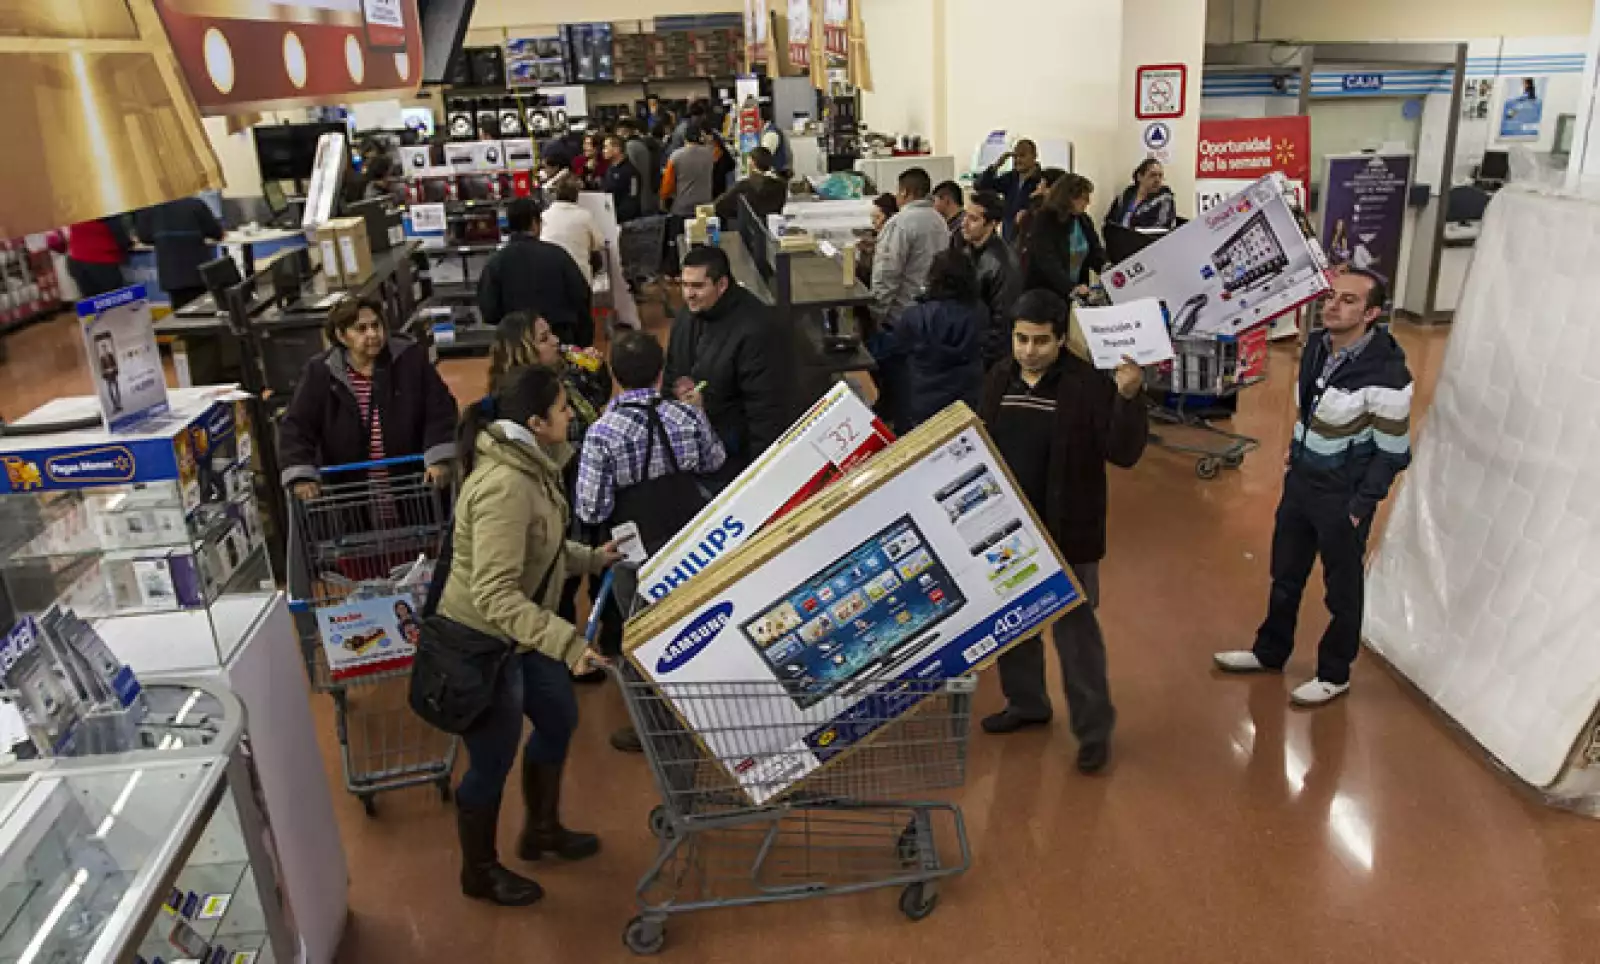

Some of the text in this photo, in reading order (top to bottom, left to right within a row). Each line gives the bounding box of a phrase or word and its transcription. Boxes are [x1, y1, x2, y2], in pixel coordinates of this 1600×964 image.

[1346, 76, 1380, 88] CAJA
[1199, 135, 1272, 156] Oportunidad
[1200, 156, 1272, 171] de la semana
[1126, 261, 1146, 279] LG
[648, 514, 746, 599] PHILIPS
[660, 611, 728, 663] SAMSUNG
